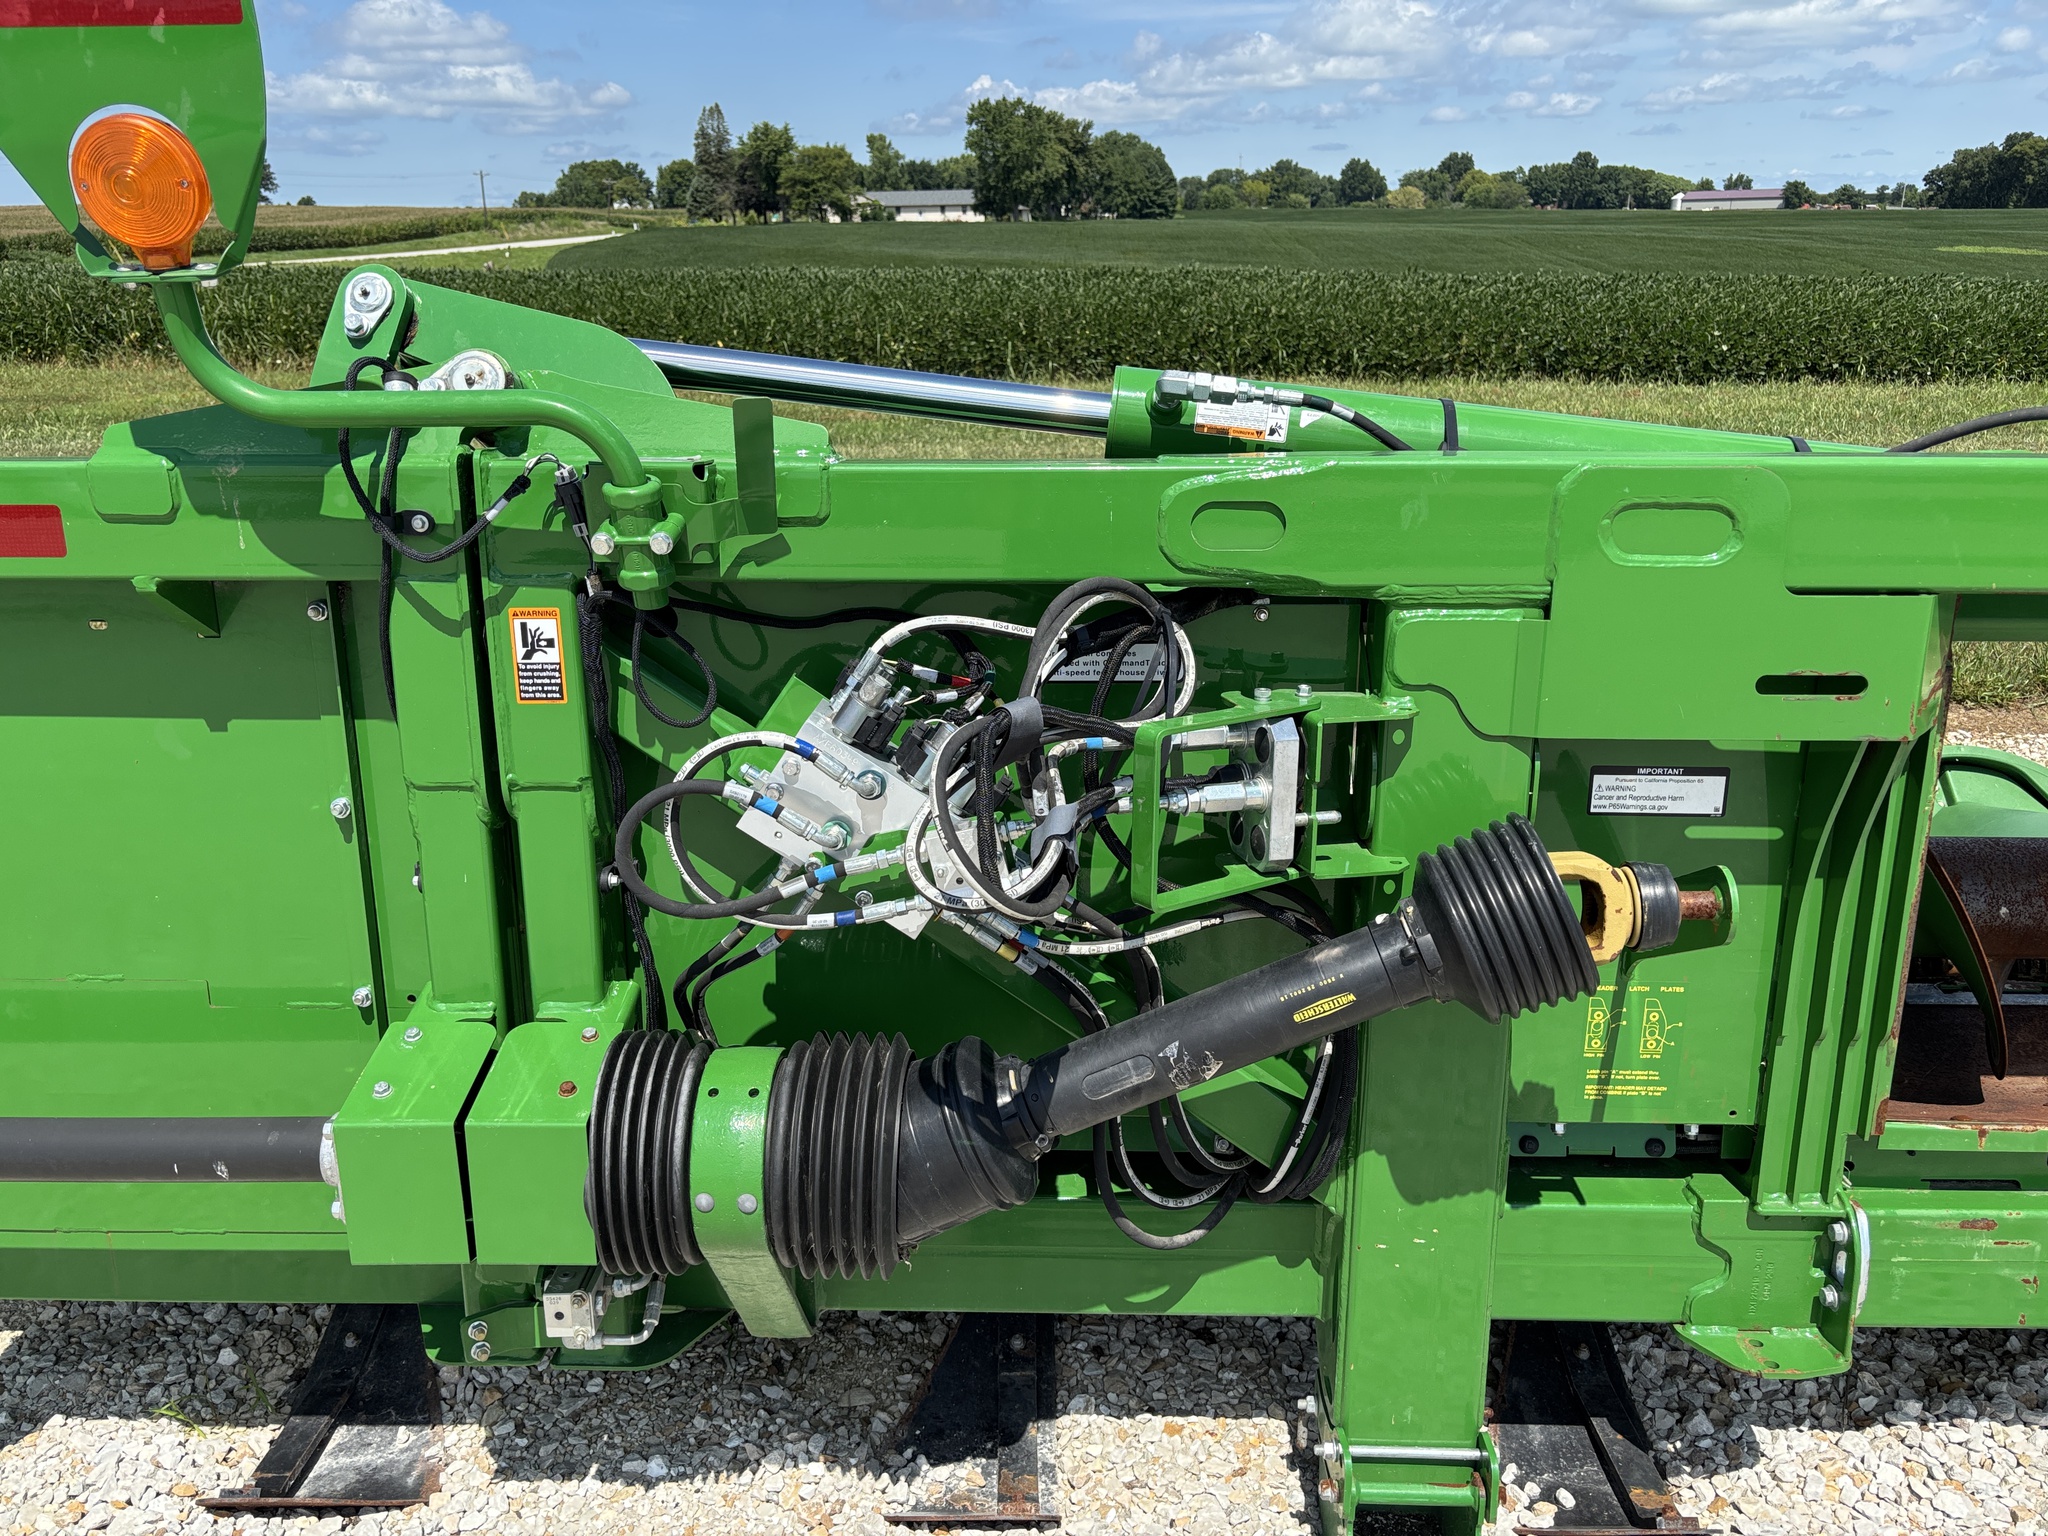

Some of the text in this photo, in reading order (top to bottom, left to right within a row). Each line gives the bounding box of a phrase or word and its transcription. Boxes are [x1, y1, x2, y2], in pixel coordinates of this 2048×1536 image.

[992, 621, 1010, 631] PSI)
[1012, 625, 1032, 635] (3000
[1593, 803, 1668, 811] www.P65Warnings.ca.gov
[934, 892, 943, 902] 21
[947, 897, 967, 906] MPa
[1042, 941, 1058, 951] MPa
[1293, 992, 1356, 1022] WALTERSCHEID
[1205, 1186, 1217, 1196] MPa
